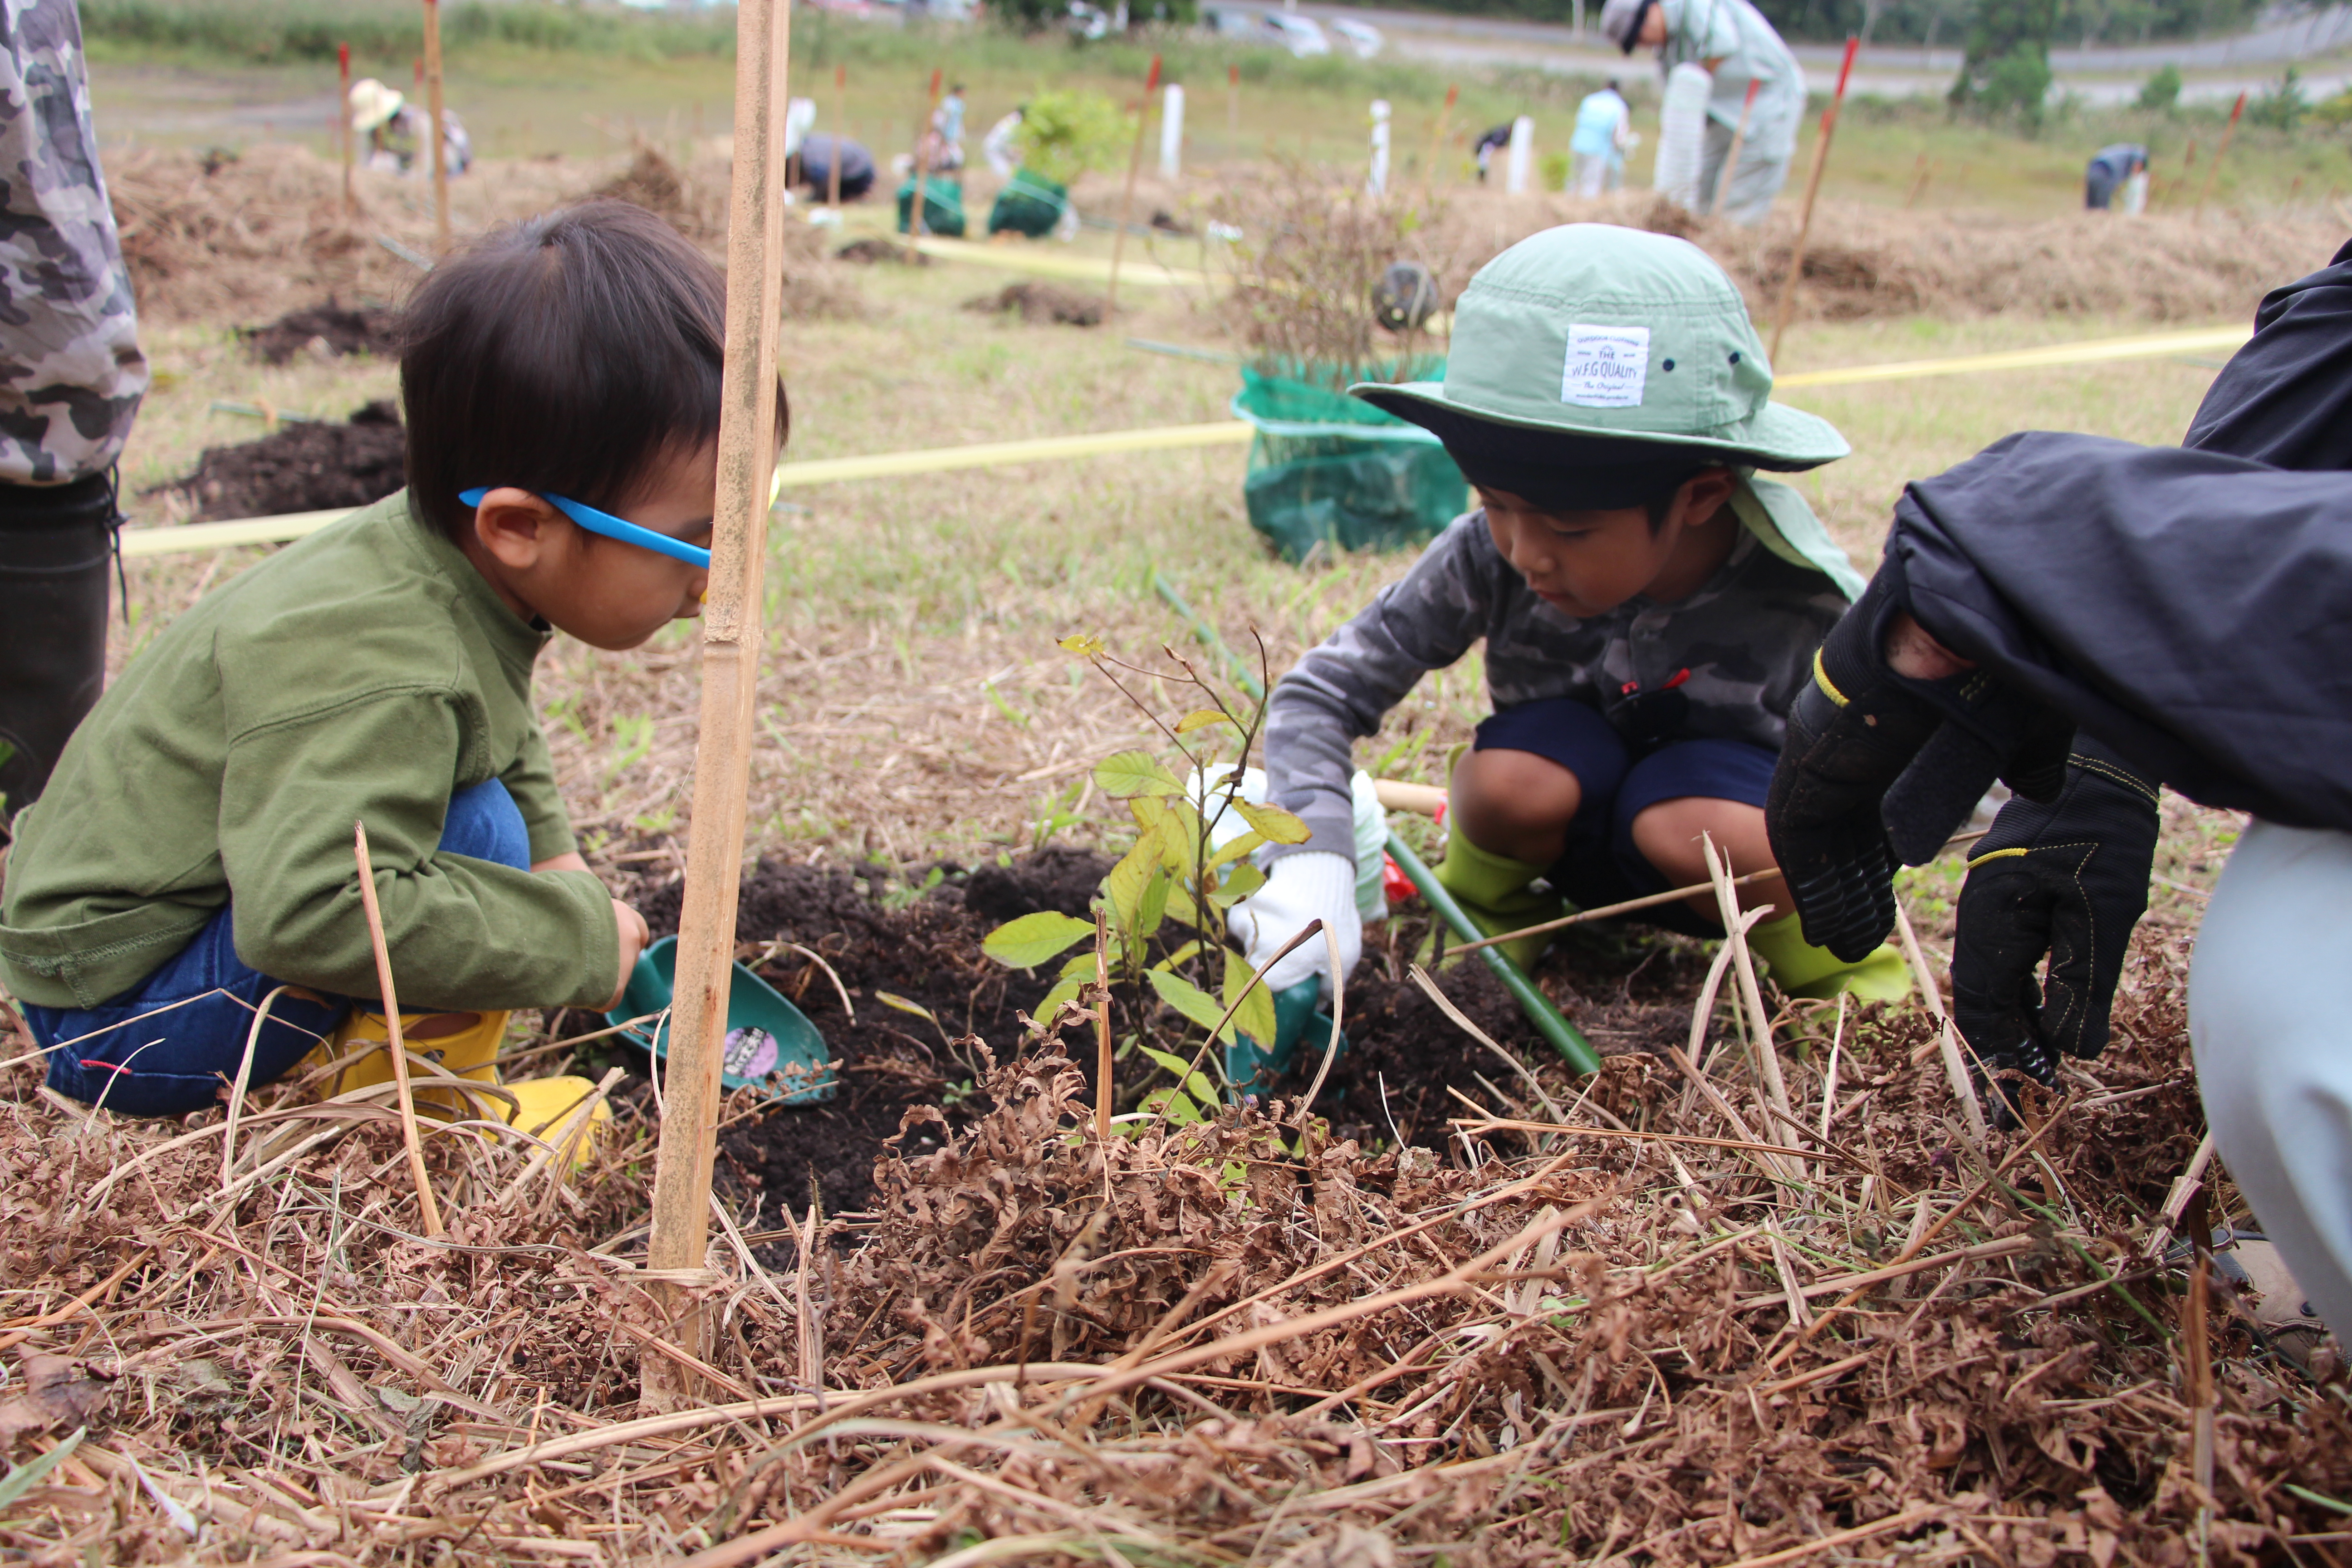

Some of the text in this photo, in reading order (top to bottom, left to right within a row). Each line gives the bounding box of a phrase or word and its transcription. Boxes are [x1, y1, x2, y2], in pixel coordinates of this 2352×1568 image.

[1599, 350, 1615, 359] THE
[1601, 361, 1637, 378] QUALITY
[1597, 382, 1625, 392] Original
